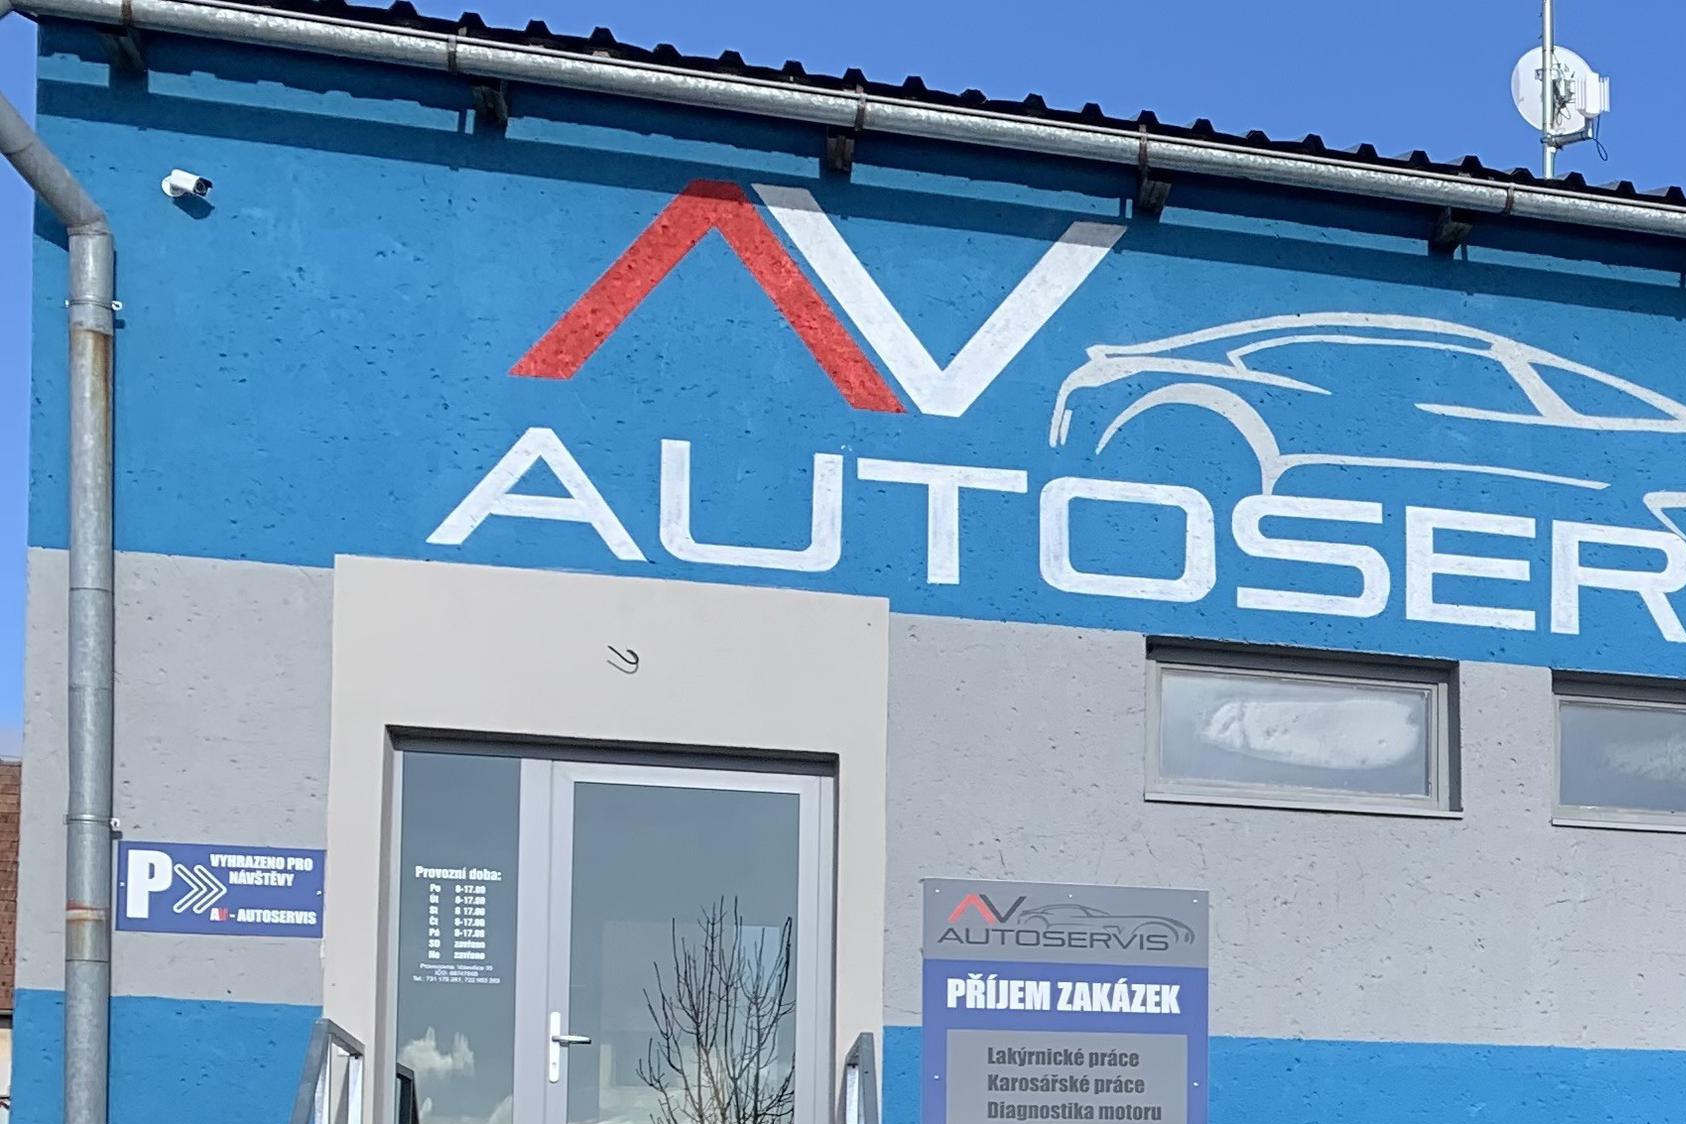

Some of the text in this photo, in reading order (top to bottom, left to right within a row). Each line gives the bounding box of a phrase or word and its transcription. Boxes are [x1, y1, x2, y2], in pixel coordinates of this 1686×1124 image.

[508, 180, 1128, 417] AV
[210, 853, 314, 871] VYHRAZENO PRO
[415, 865, 502, 881] Provozní doba:
[126, 849, 173, 919] P
[229, 870, 294, 887] NÁVŠTĚVY
[236, 908, 317, 925] AUTOSERVIS
[947, 892, 1027, 926] AV
[936, 927, 1170, 951] AUTOSERVIS
[946, 972, 1182, 1014] PŘÍJEM ZAKÁZEK
[987, 1046, 1140, 1068] Lakýrnické práce
[987, 1073, 1146, 1095] Karosářské práce
[987, 1101, 1162, 1121] Diagnostika motoru
